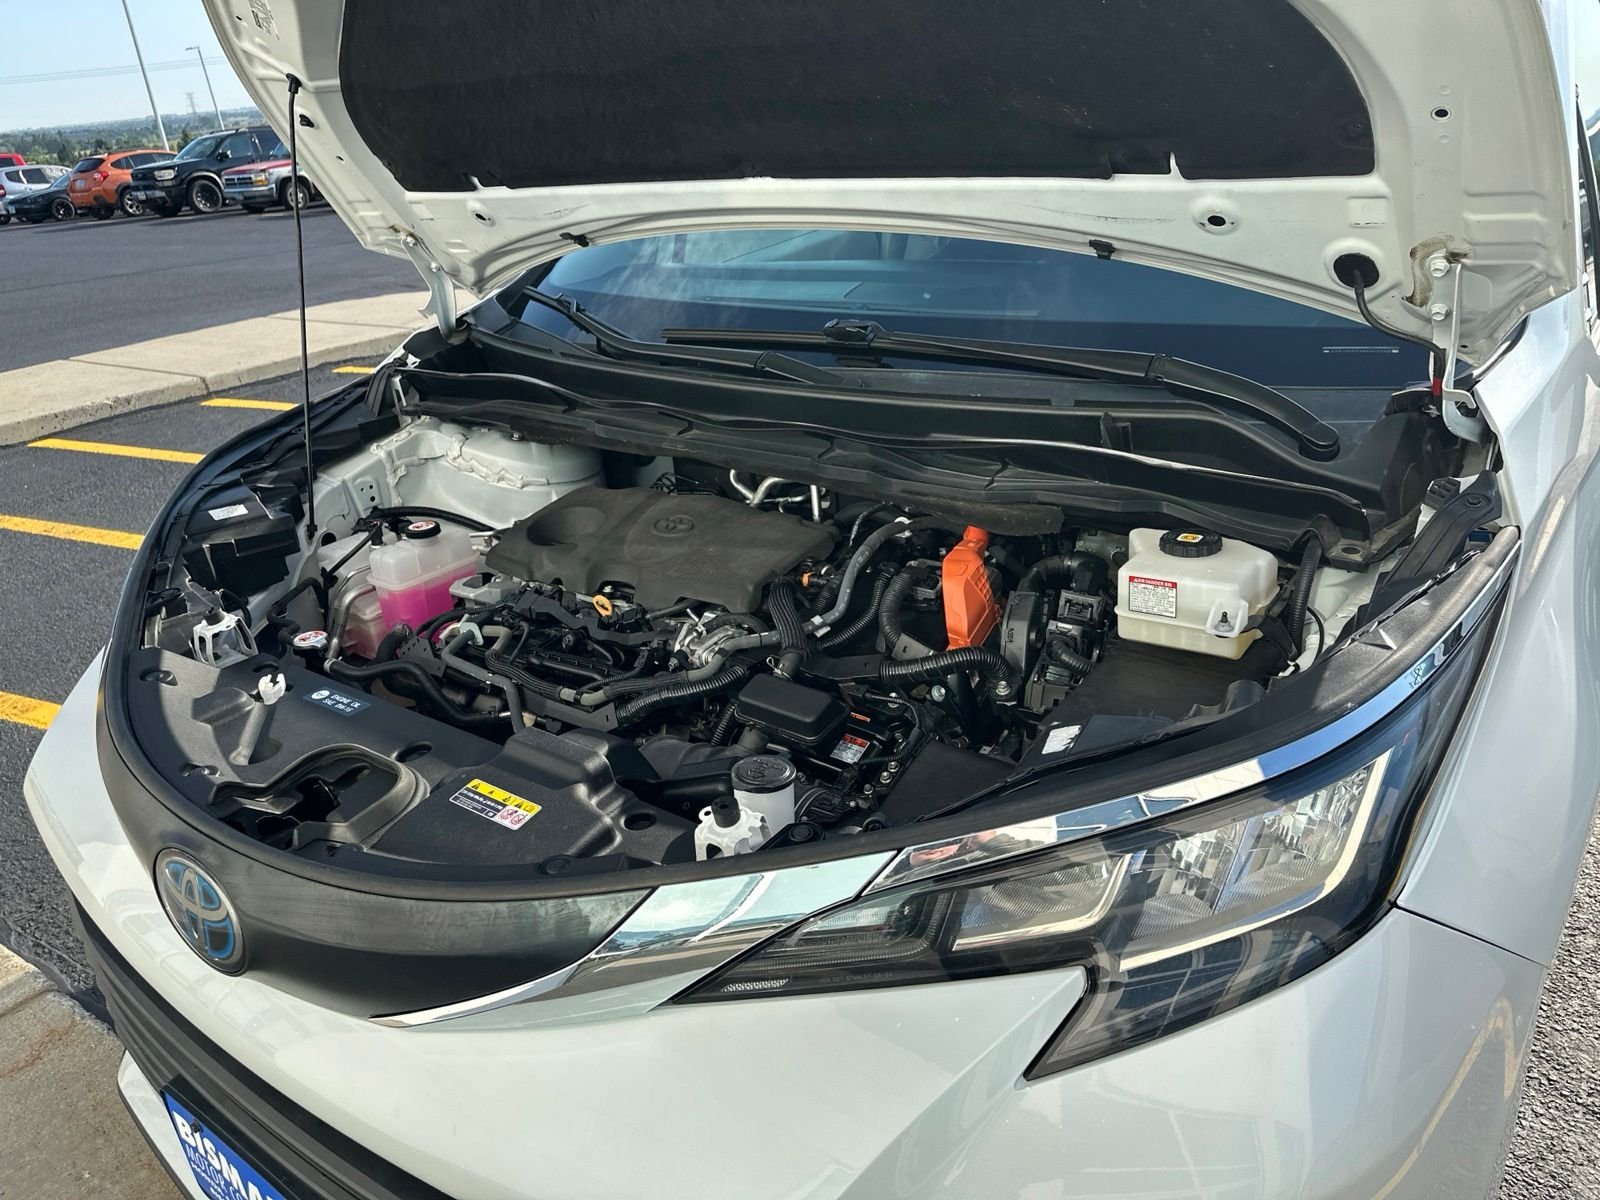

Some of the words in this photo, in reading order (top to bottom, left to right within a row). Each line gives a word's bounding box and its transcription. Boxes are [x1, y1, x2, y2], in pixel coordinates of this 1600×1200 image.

[322, 698, 337, 706] SAE
[330, 693, 352, 705] ENGINE
[185, 1143, 228, 1193] MOTOR
